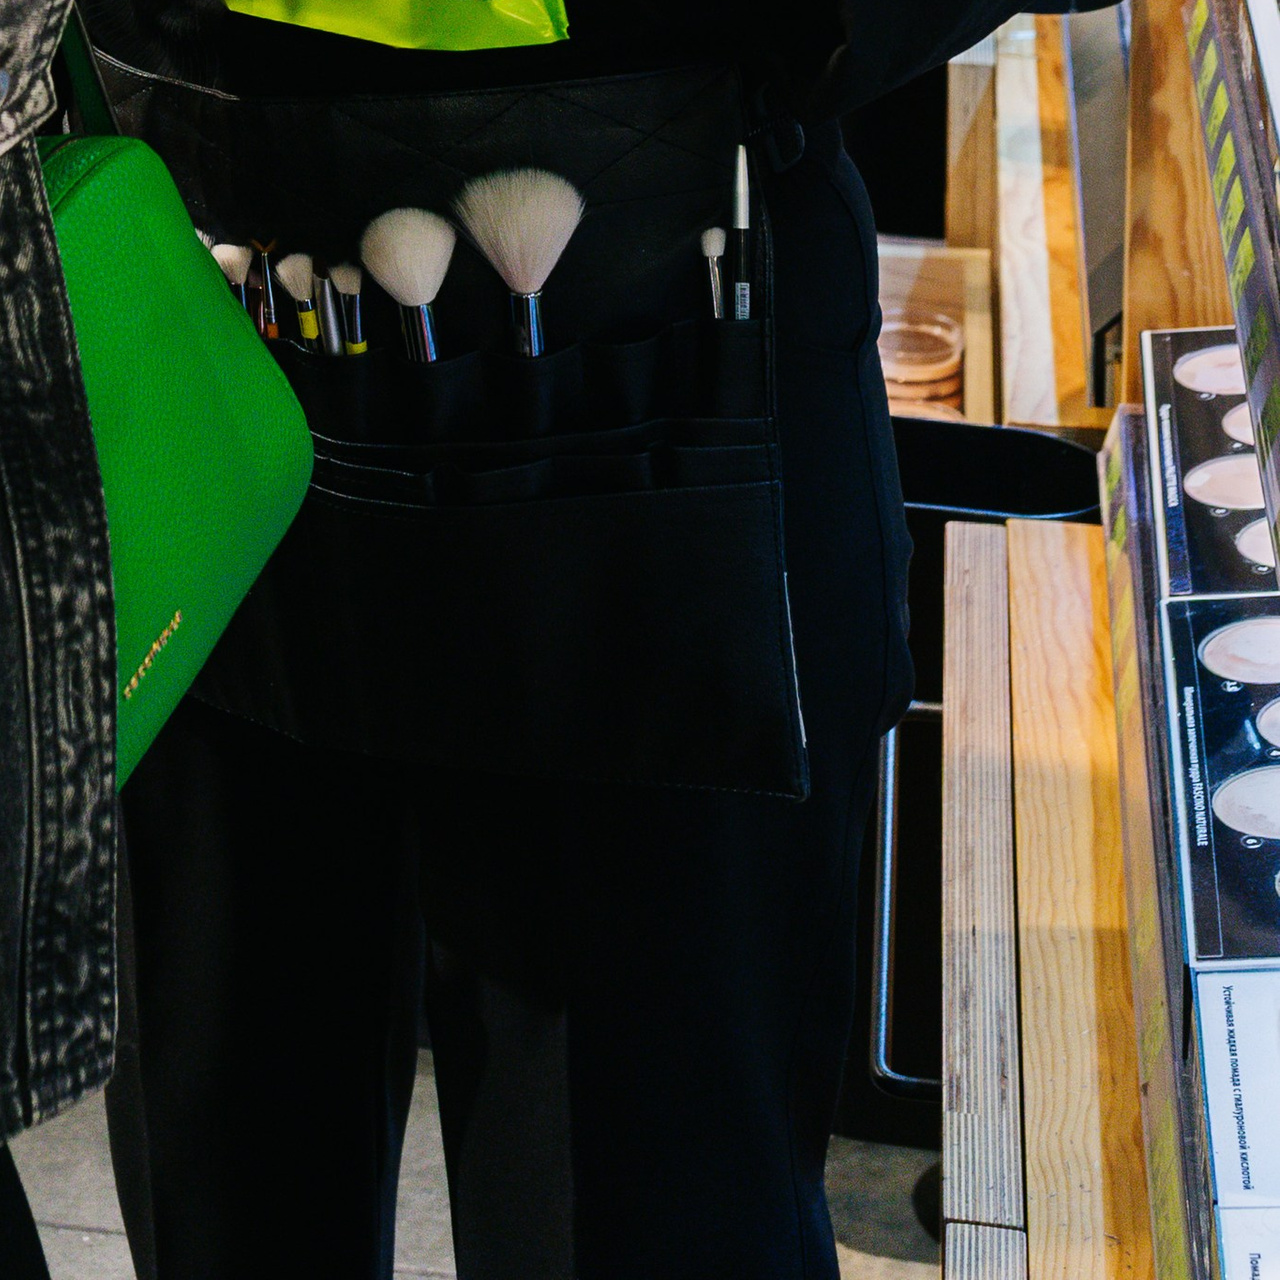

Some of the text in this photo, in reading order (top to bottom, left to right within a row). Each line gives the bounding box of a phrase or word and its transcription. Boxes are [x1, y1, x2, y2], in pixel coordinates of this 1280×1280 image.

[1192, 783, 1205, 810] FASCINO
[1195, 811, 1208, 847] NATURALE
[1222, 985, 1236, 1027] Устойчивая
[1227, 1029, 1238, 1057] жидкая
[1230, 1058, 1241, 1087] помада
[1232, 1093, 1251, 1150] гиалуроновой
[1240, 1151, 1255, 1190] кислотой
[1249, 1253, 1261, 1280] Пома
